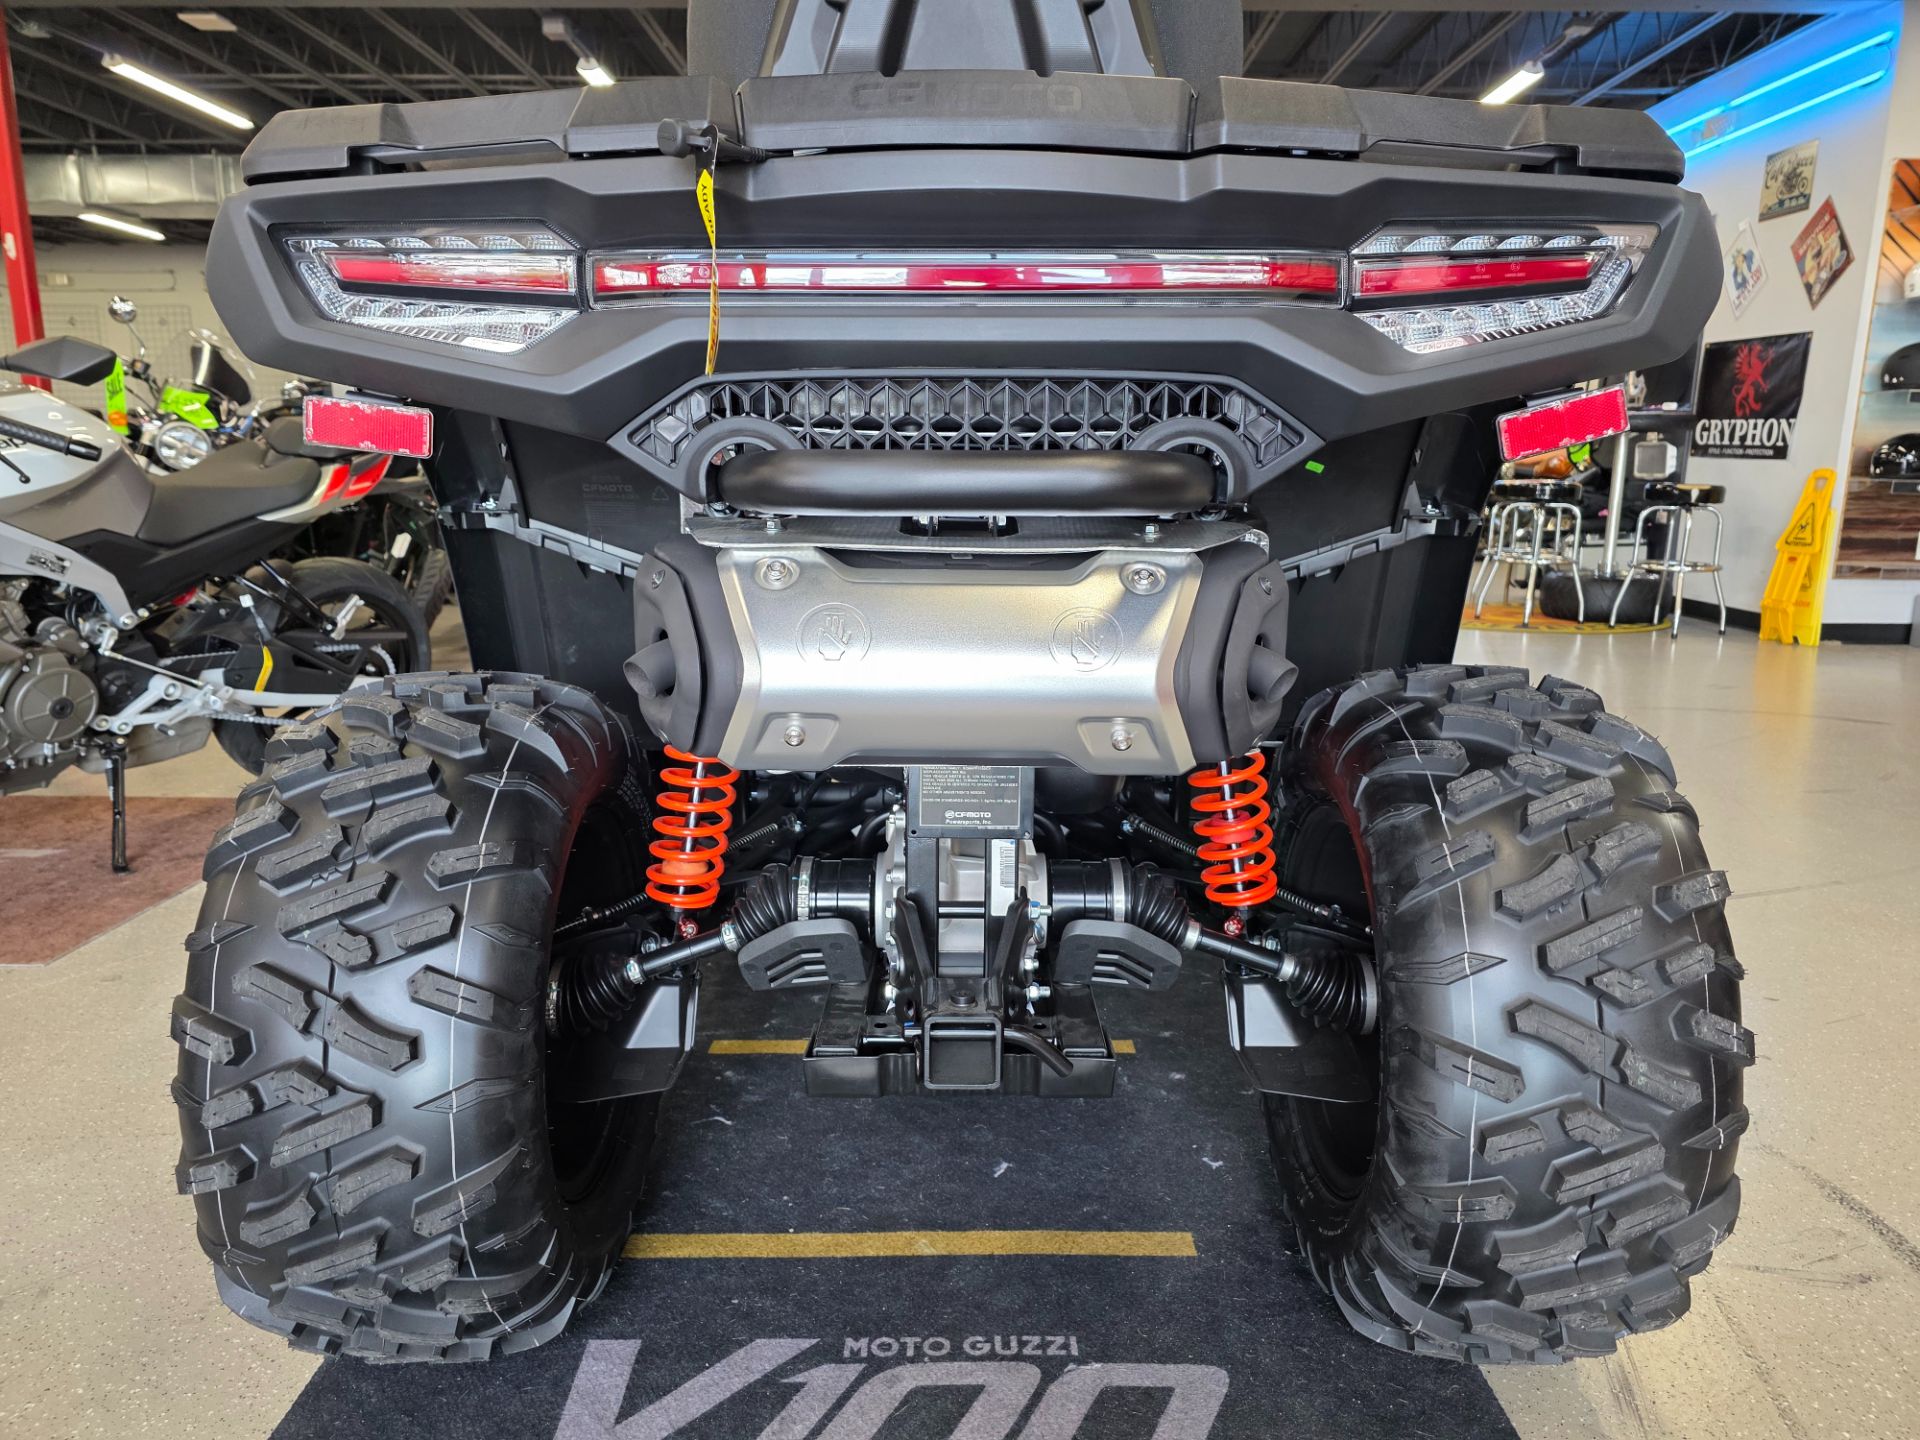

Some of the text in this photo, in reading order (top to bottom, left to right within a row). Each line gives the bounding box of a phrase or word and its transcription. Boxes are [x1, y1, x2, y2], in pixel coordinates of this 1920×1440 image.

[1694, 418, 1796, 446] GRYPHON
[582, 483, 633, 492] CFMOTO
[842, 1334, 1080, 1358] MOTO GUZZI
